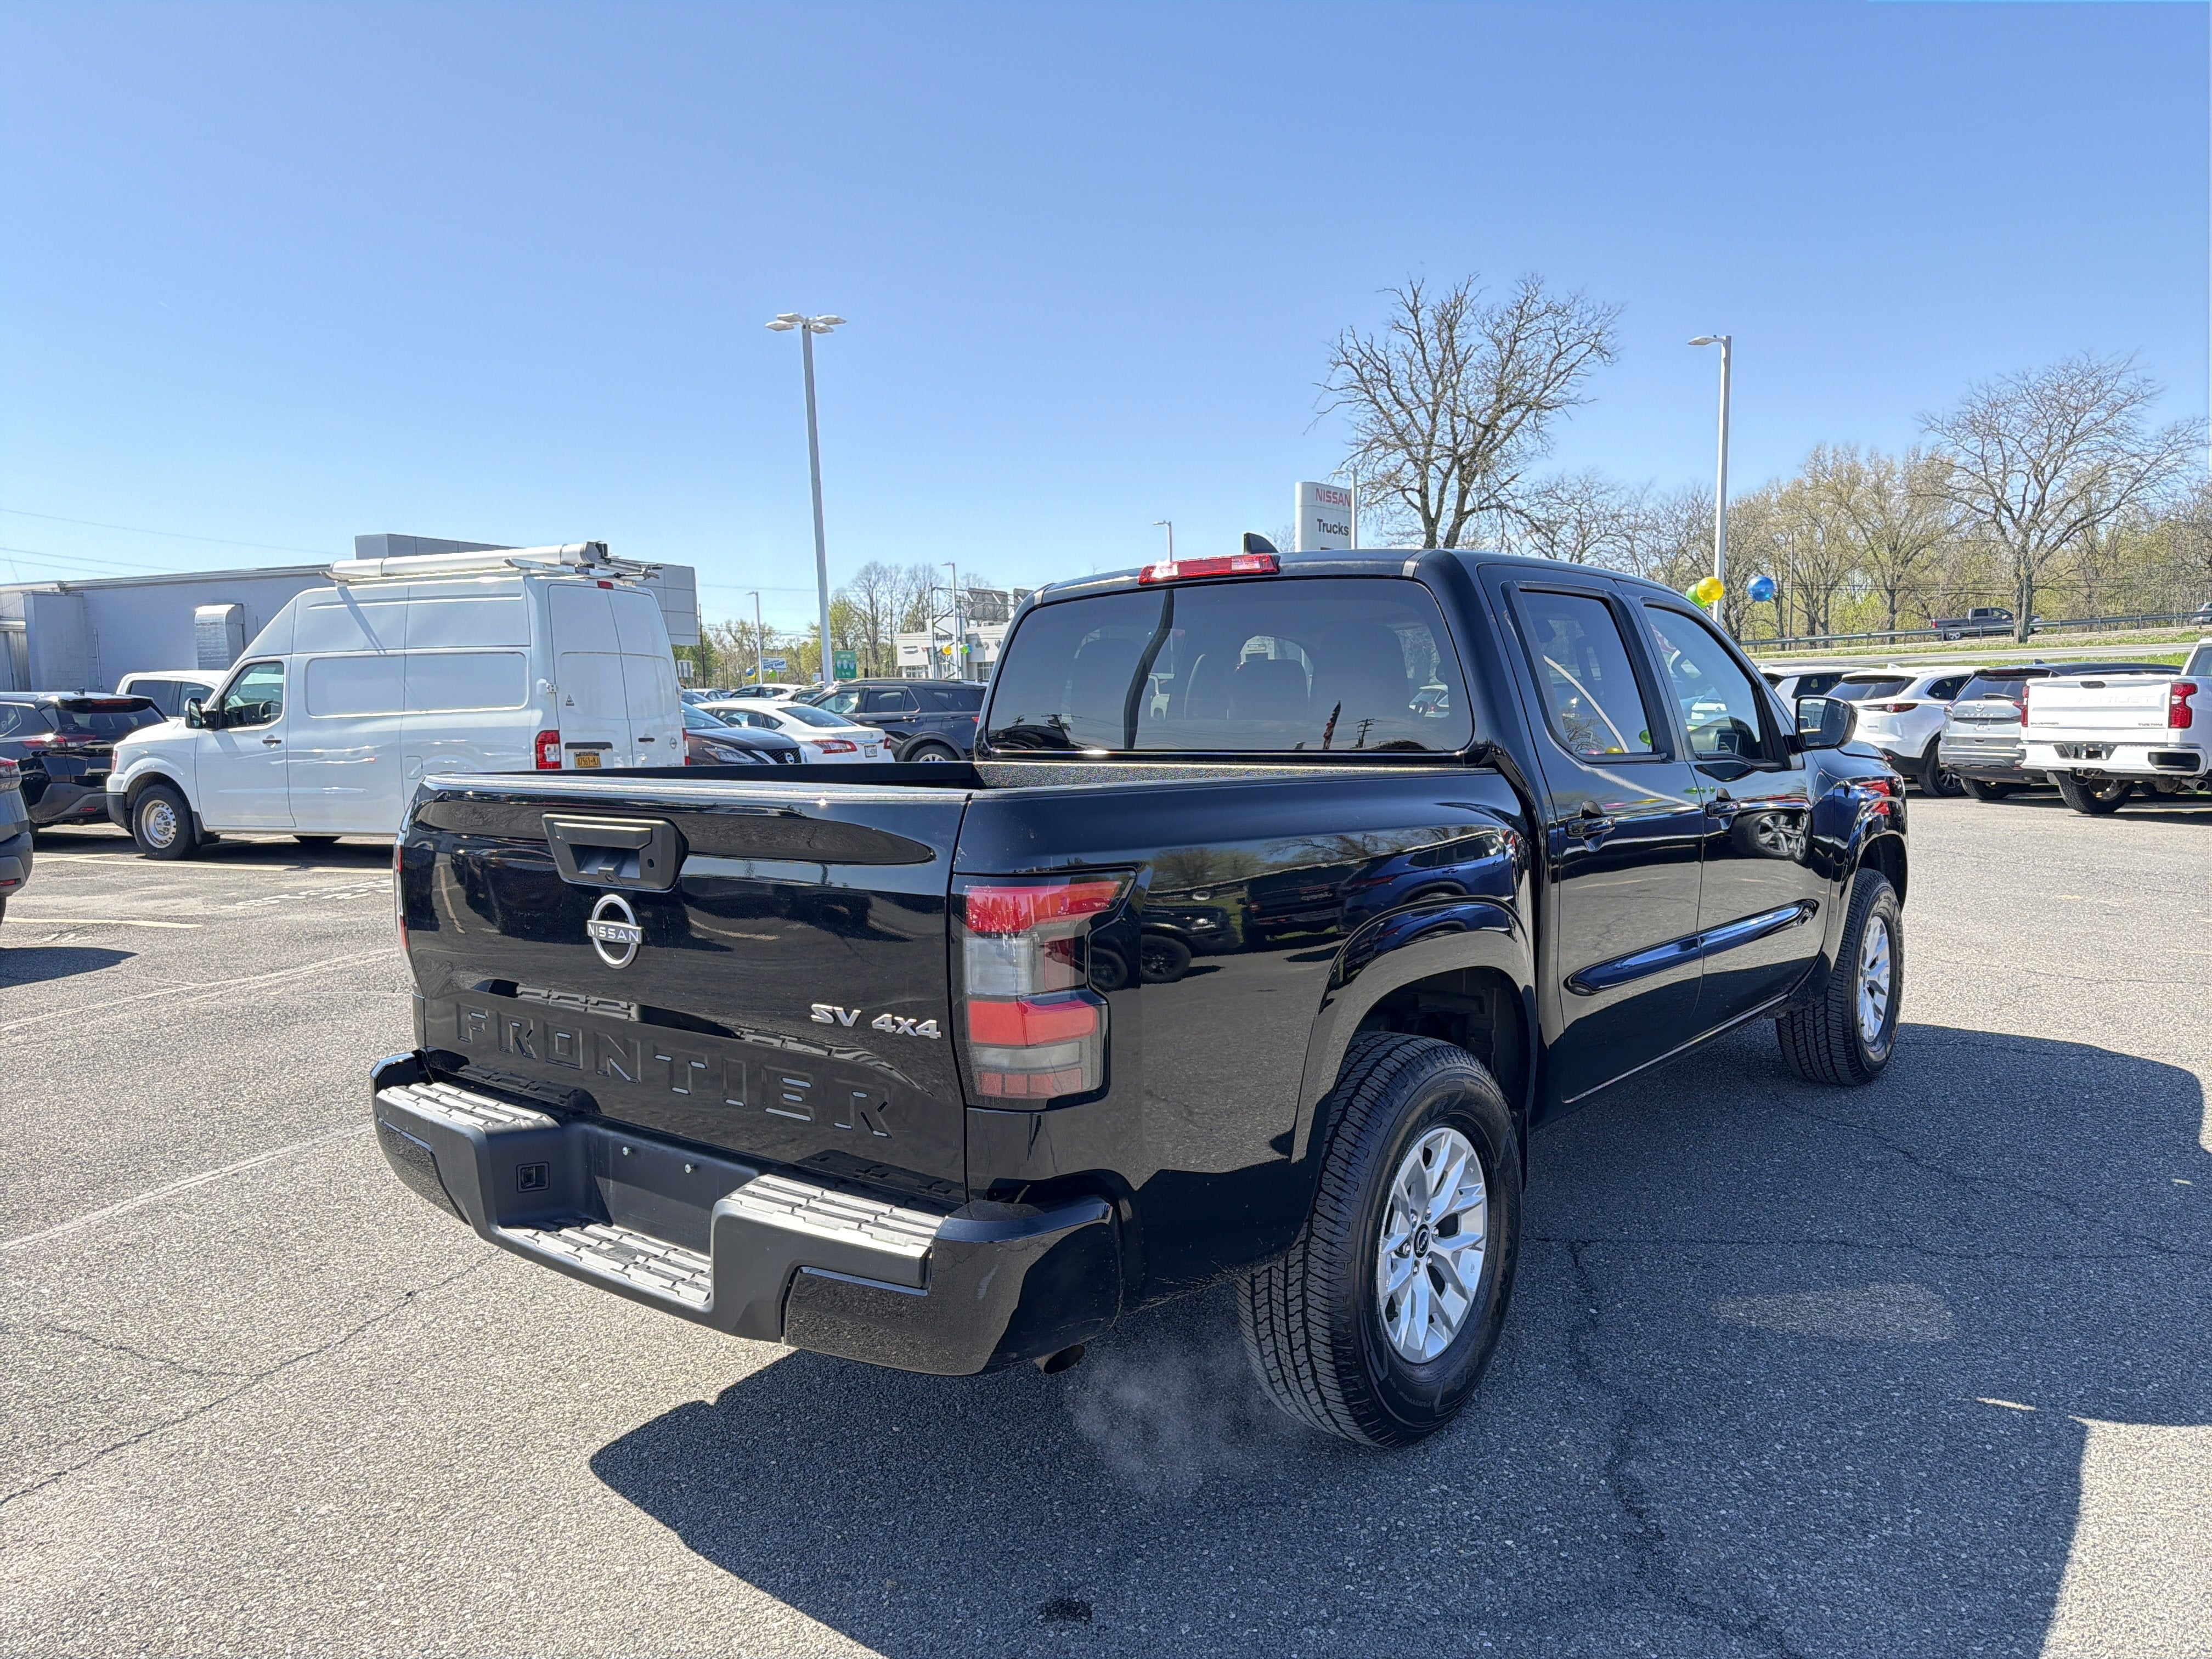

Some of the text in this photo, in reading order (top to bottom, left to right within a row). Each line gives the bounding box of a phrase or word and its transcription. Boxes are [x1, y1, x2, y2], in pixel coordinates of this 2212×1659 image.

[1316, 488, 1351, 507] NISSAN
[1317, 518, 1349, 537] Trucks
[588, 923, 639, 942] NISSAN
[811, 1003, 861, 1027] SV
[456, 1002, 892, 1138] FRONTIER
